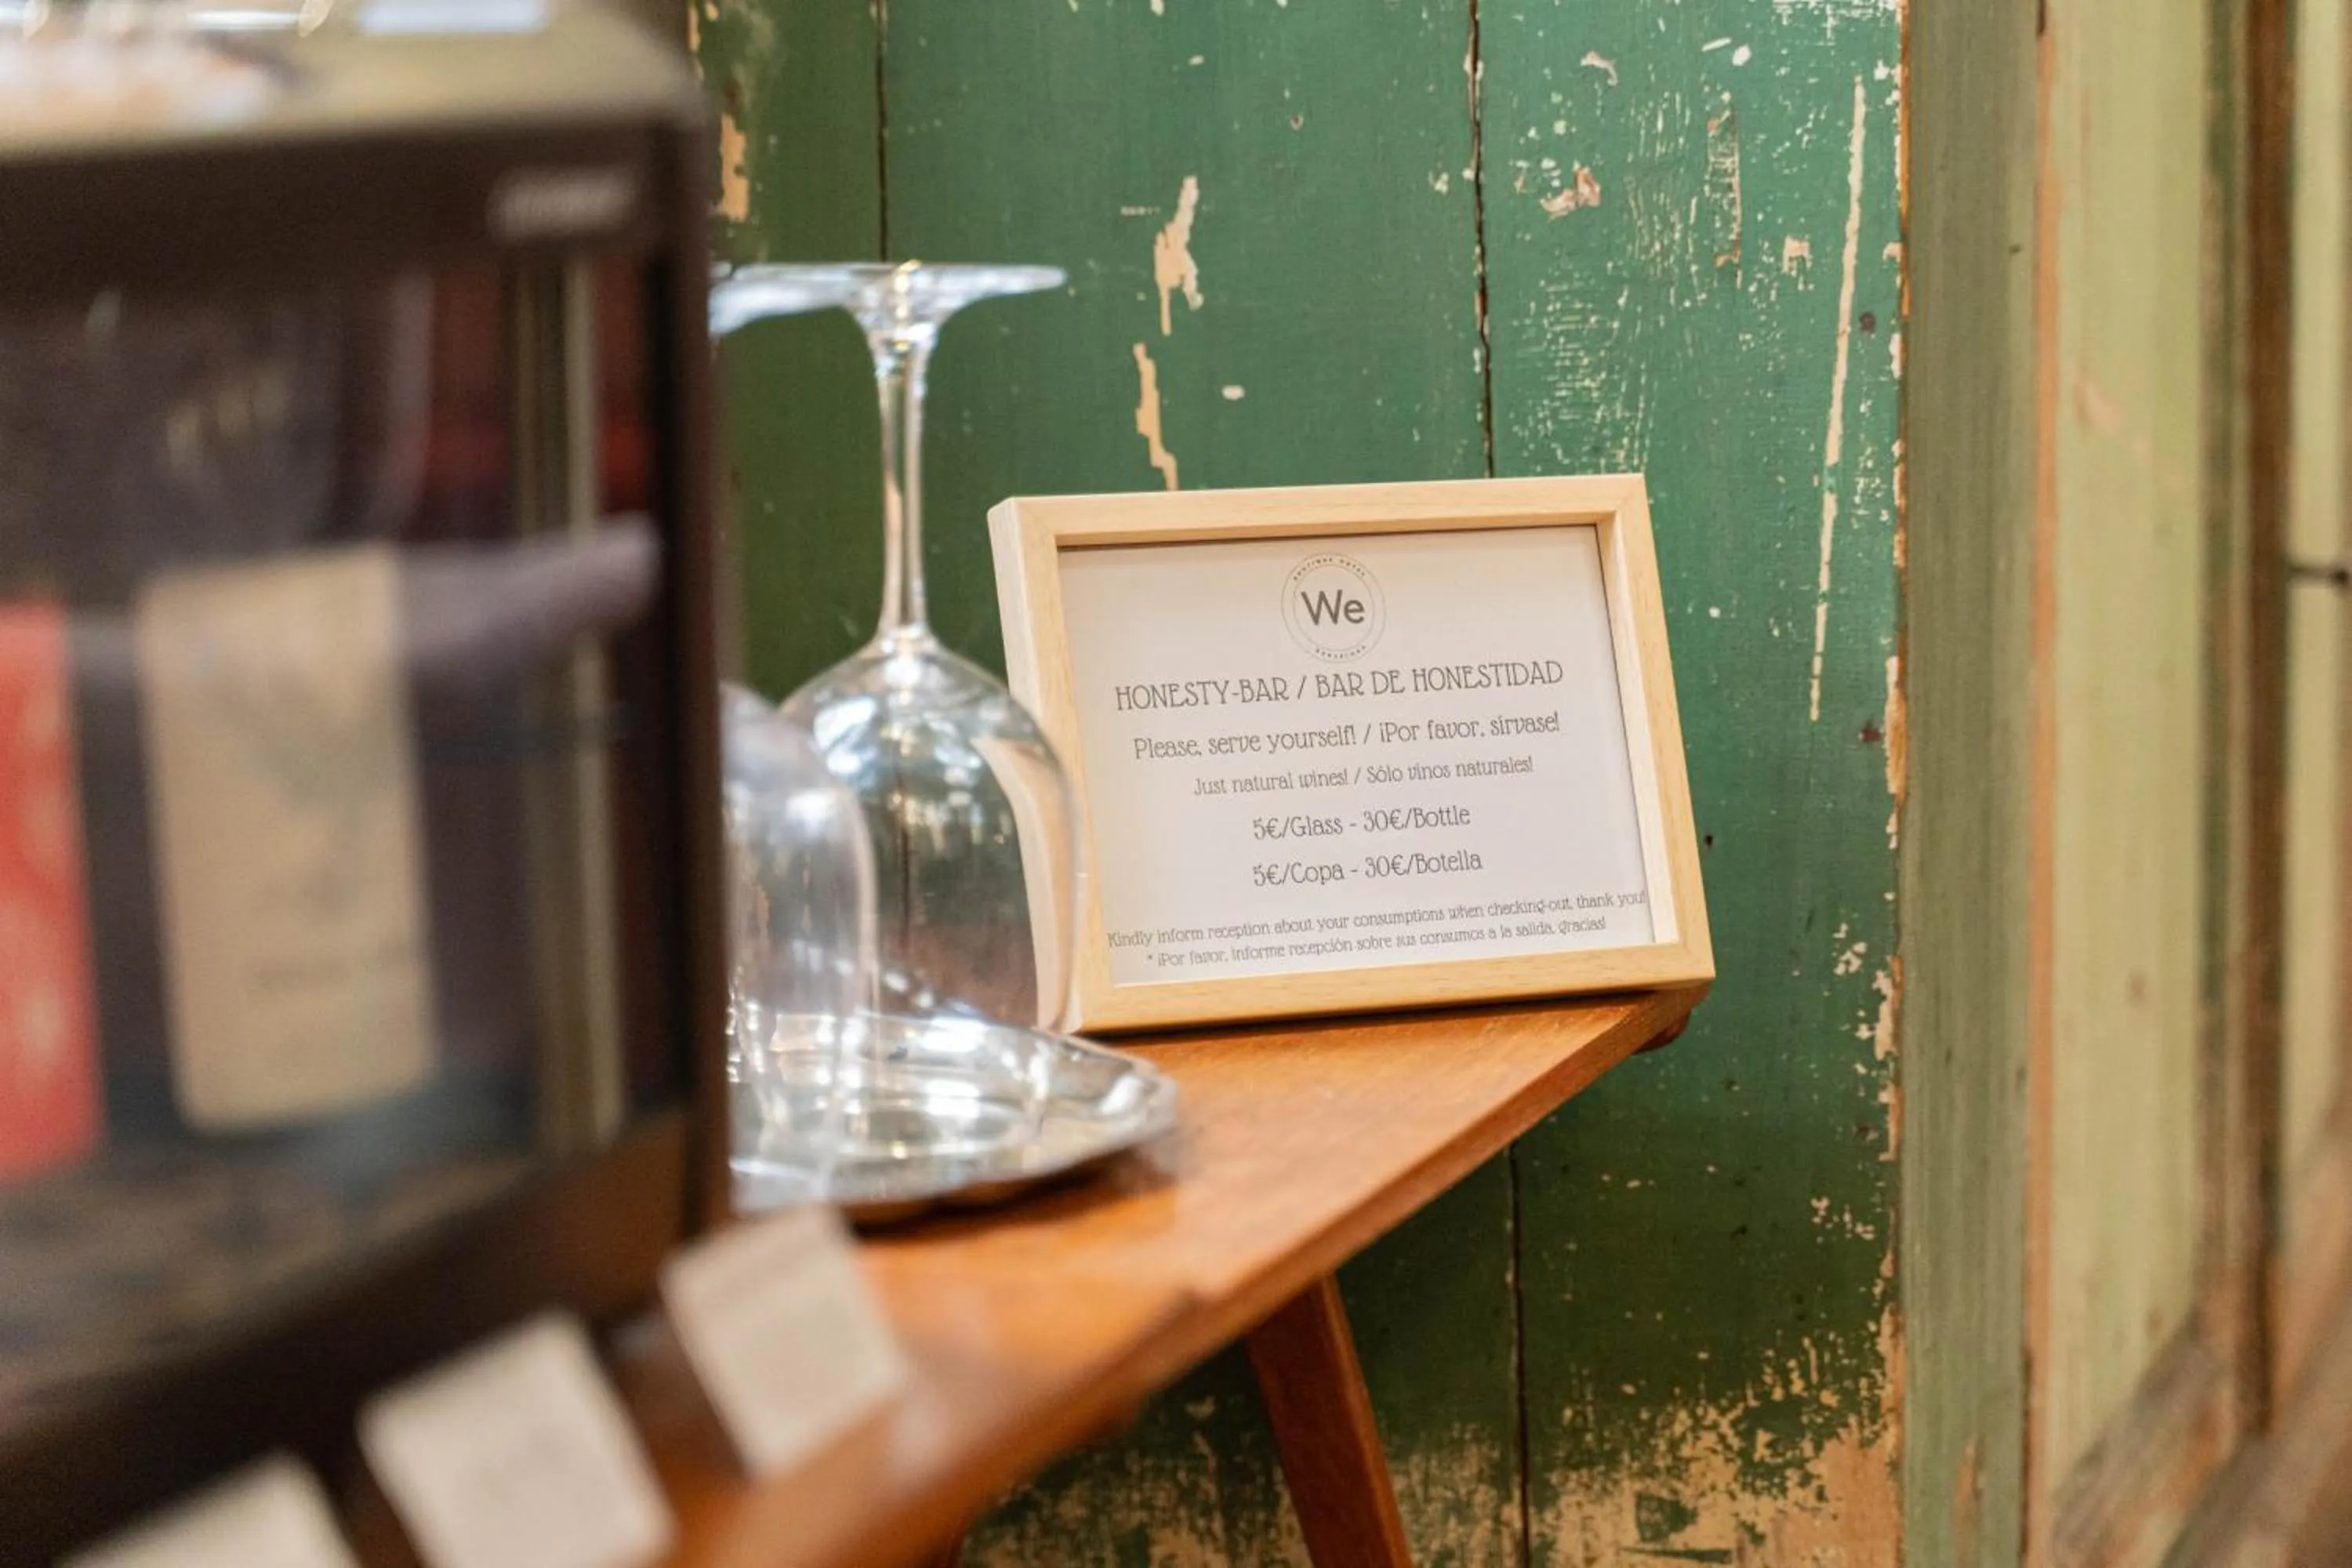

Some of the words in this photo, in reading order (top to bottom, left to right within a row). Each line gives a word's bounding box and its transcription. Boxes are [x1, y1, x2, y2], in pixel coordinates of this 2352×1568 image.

[1301, 590, 1366, 626] We
[1116, 677, 1290, 711] HONESTY-BAR
[1298, 675, 1307, 699] /
[1316, 672, 1364, 699] BAR
[1372, 670, 1406, 695] DE
[1412, 660, 1564, 692] HONESTIDAD
[1208, 734, 1261, 754] serve
[1267, 725, 1357, 754] yourself!
[1490, 710, 1560, 737] sírvase!
[1194, 778, 1228, 797] Just
[1232, 771, 1294, 793] natural
[1298, 768, 1348, 789] wines!
[1367, 764, 1403, 785] Sólo
[1408, 762, 1451, 780] vinos
[1455, 755, 1534, 778] naturales!
[1254, 815, 1344, 840] 5€/Glass
[1363, 804, 1471, 833] 30€/Bottle
[1254, 862, 1345, 887] 5€/Copa
[1364, 849, 1483, 879] 30€/Botella
[1107, 931, 1152, 948] Kindly
[1157, 927, 1203, 943] inform
[1208, 921, 1270, 940] reception
[1274, 918, 1313, 934] about
[1316, 916, 1349, 932] your
[1353, 907, 1445, 927] consumptions
[1448, 903, 1484, 920] when
[1577, 892, 1614, 909] thank
[1232, 944, 1285, 963] informe
[1356, 934, 1393, 950] sobre
[1396, 935, 1416, 948] sus
[1420, 927, 1486, 945] consumos
[1501, 924, 1512, 938] la
